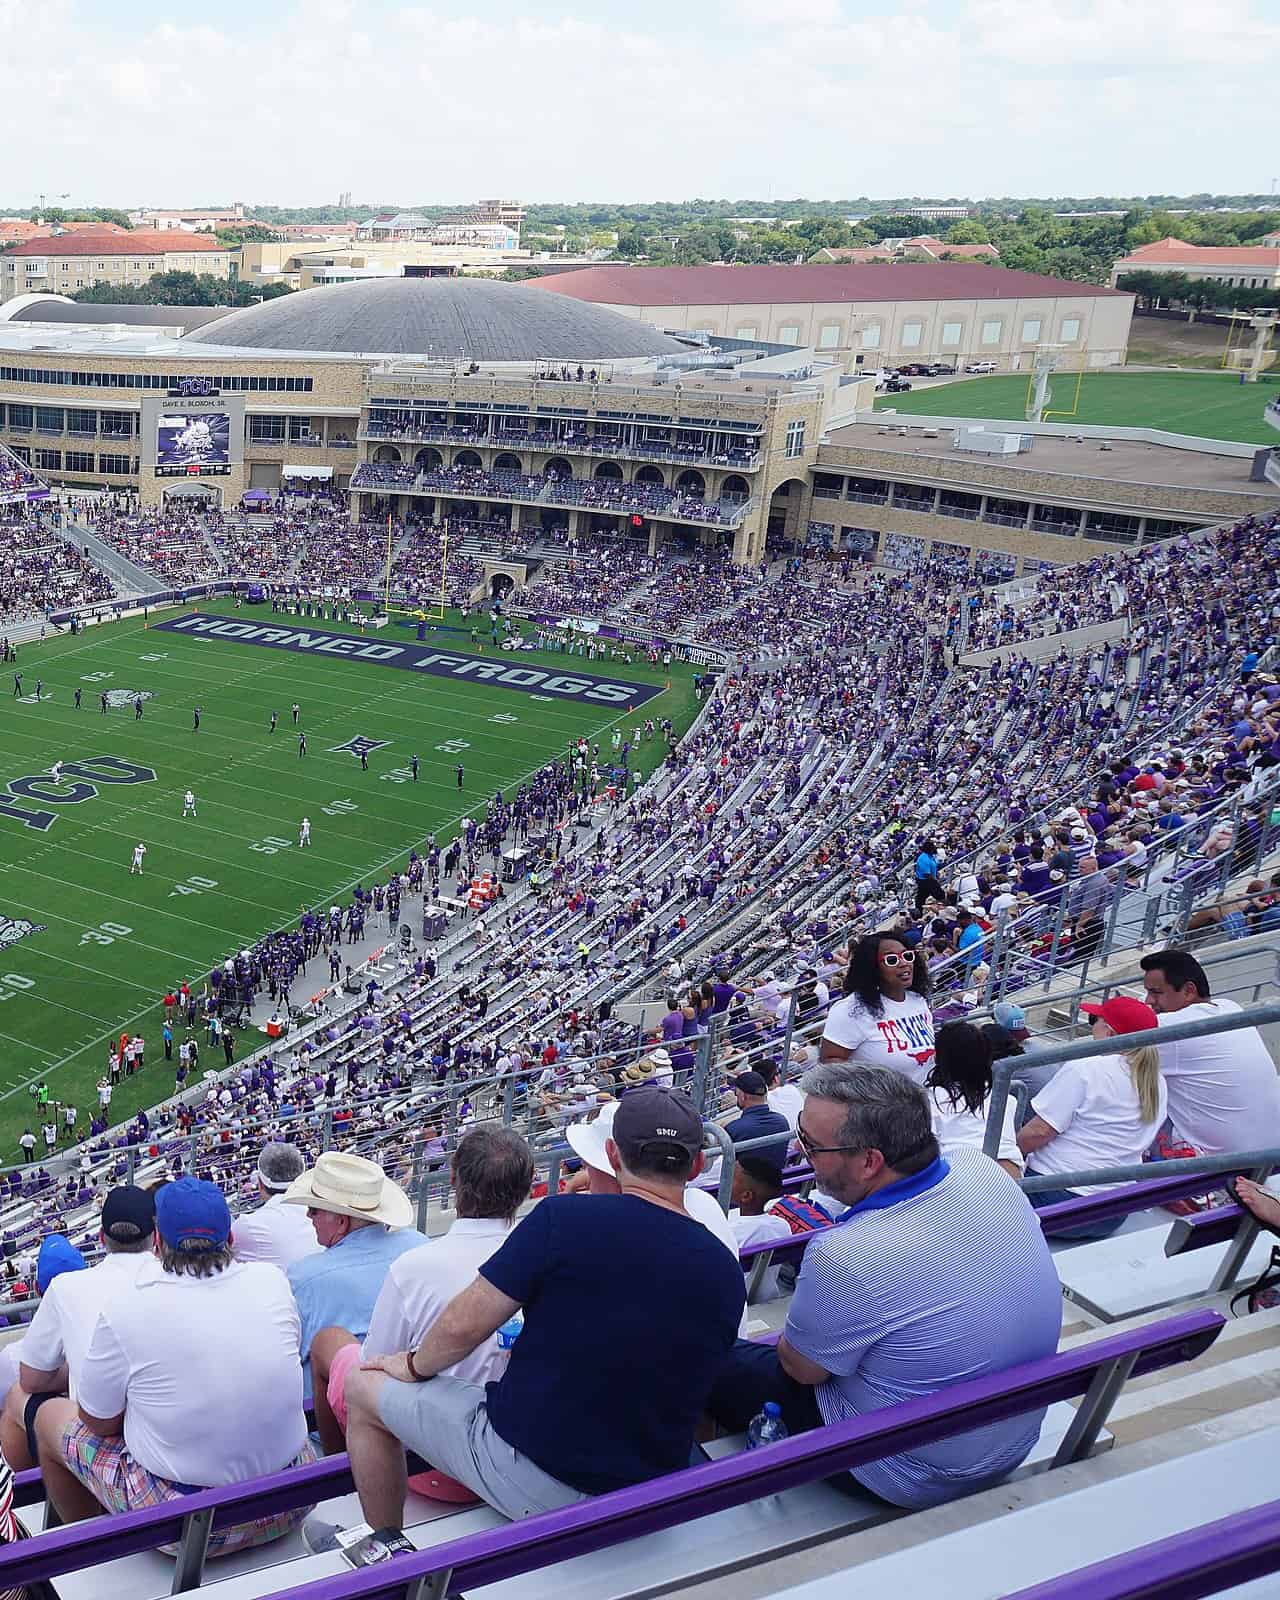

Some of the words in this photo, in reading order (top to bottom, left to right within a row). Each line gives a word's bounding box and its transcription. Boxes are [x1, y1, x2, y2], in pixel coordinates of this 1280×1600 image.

[177, 376, 211, 396] TCU
[174, 617, 406, 659] HORNED
[413, 654, 640, 702] FROGS
[81, 671, 112, 682] 20
[488, 711, 517, 724] 10
[435, 738, 470, 754] 20
[379, 768, 414, 784] 30
[322, 797, 359, 817] 40
[248, 836, 293, 854] 50
[174, 876, 219, 895] 40
[82, 922, 133, 945] 30
[877, 1013, 934, 1053] TCWH
[656, 1128, 678, 1137] SMU
